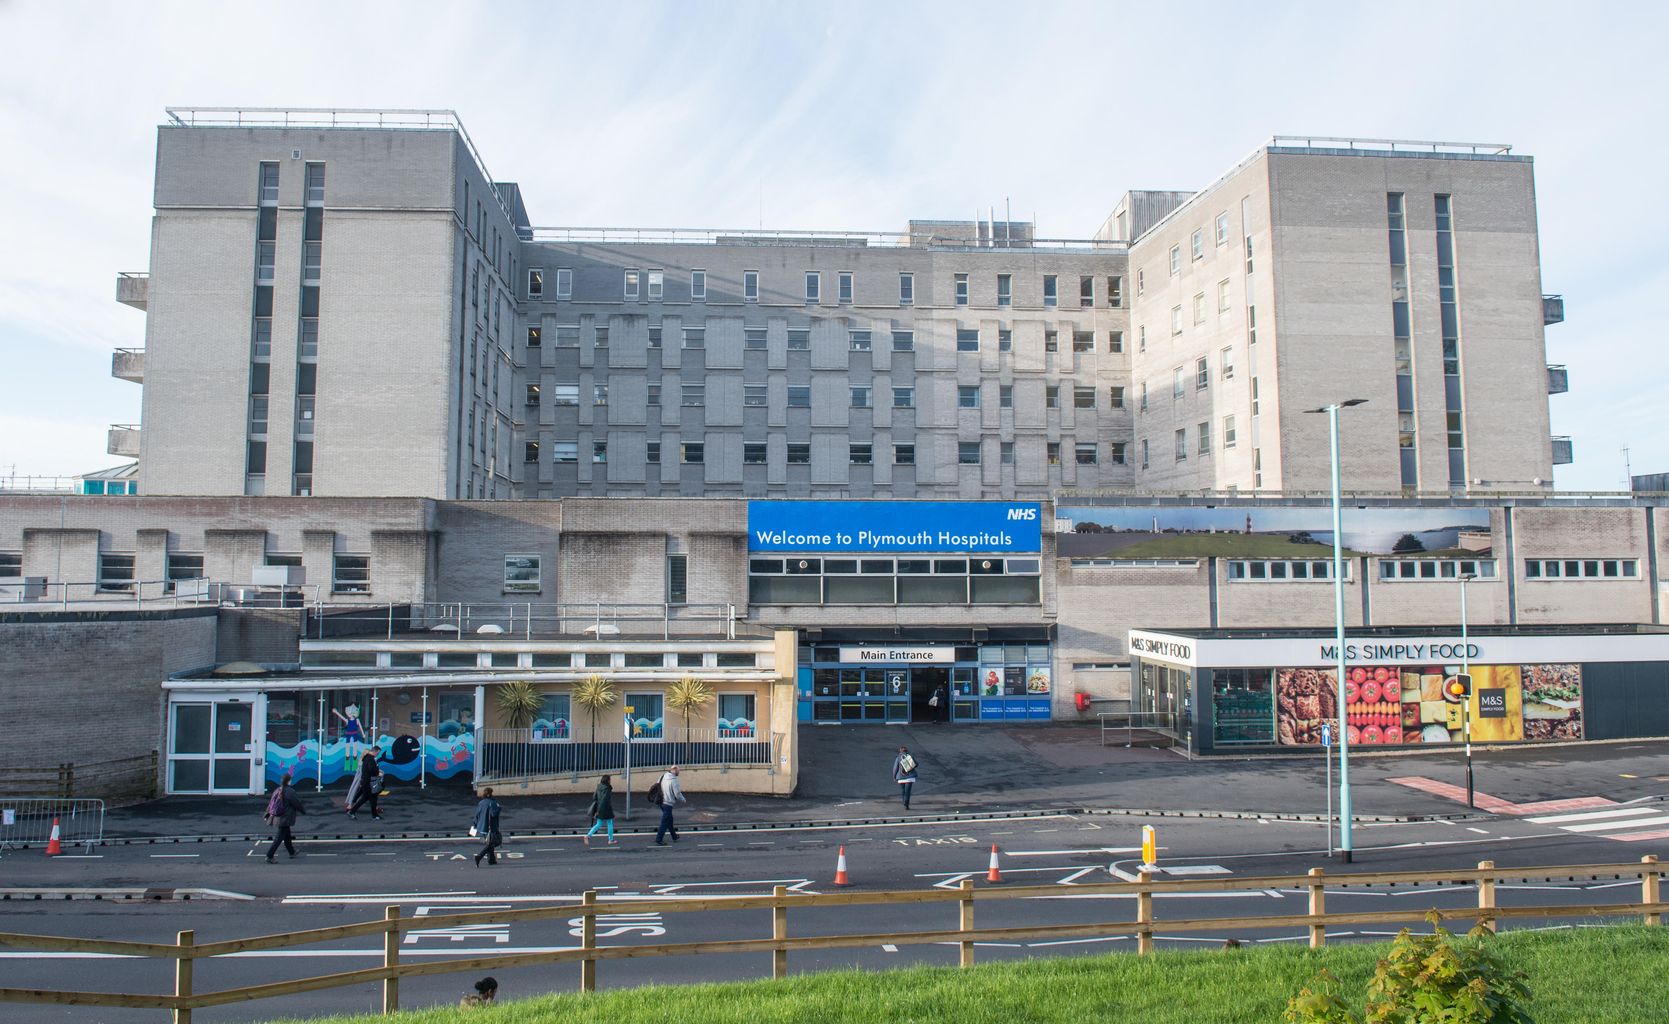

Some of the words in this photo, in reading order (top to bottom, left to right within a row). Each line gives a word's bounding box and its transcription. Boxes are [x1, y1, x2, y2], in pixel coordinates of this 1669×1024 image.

[1007, 508, 1036, 520] NHS
[756, 531, 832, 545] Welcome
[836, 532, 852, 545] to
[858, 531, 933, 549] Plymouth
[938, 531, 1012, 549] Hospitals
[1131, 636, 1145, 651] M&S
[1145, 639, 1169, 656] SIMPLY
[1169, 642, 1191, 660] FOOD
[1363, 644, 1424, 659] SIMPLY
[1429, 643, 1479, 659] FOOD
[860, 650, 887, 660] Main
[889, 650, 934, 660] Entrance
[892, 676, 901, 688] 6
[1481, 695, 1503, 706] M&S
[425, 852, 525, 861] TAIS
[403, 905, 511, 944] LNE
